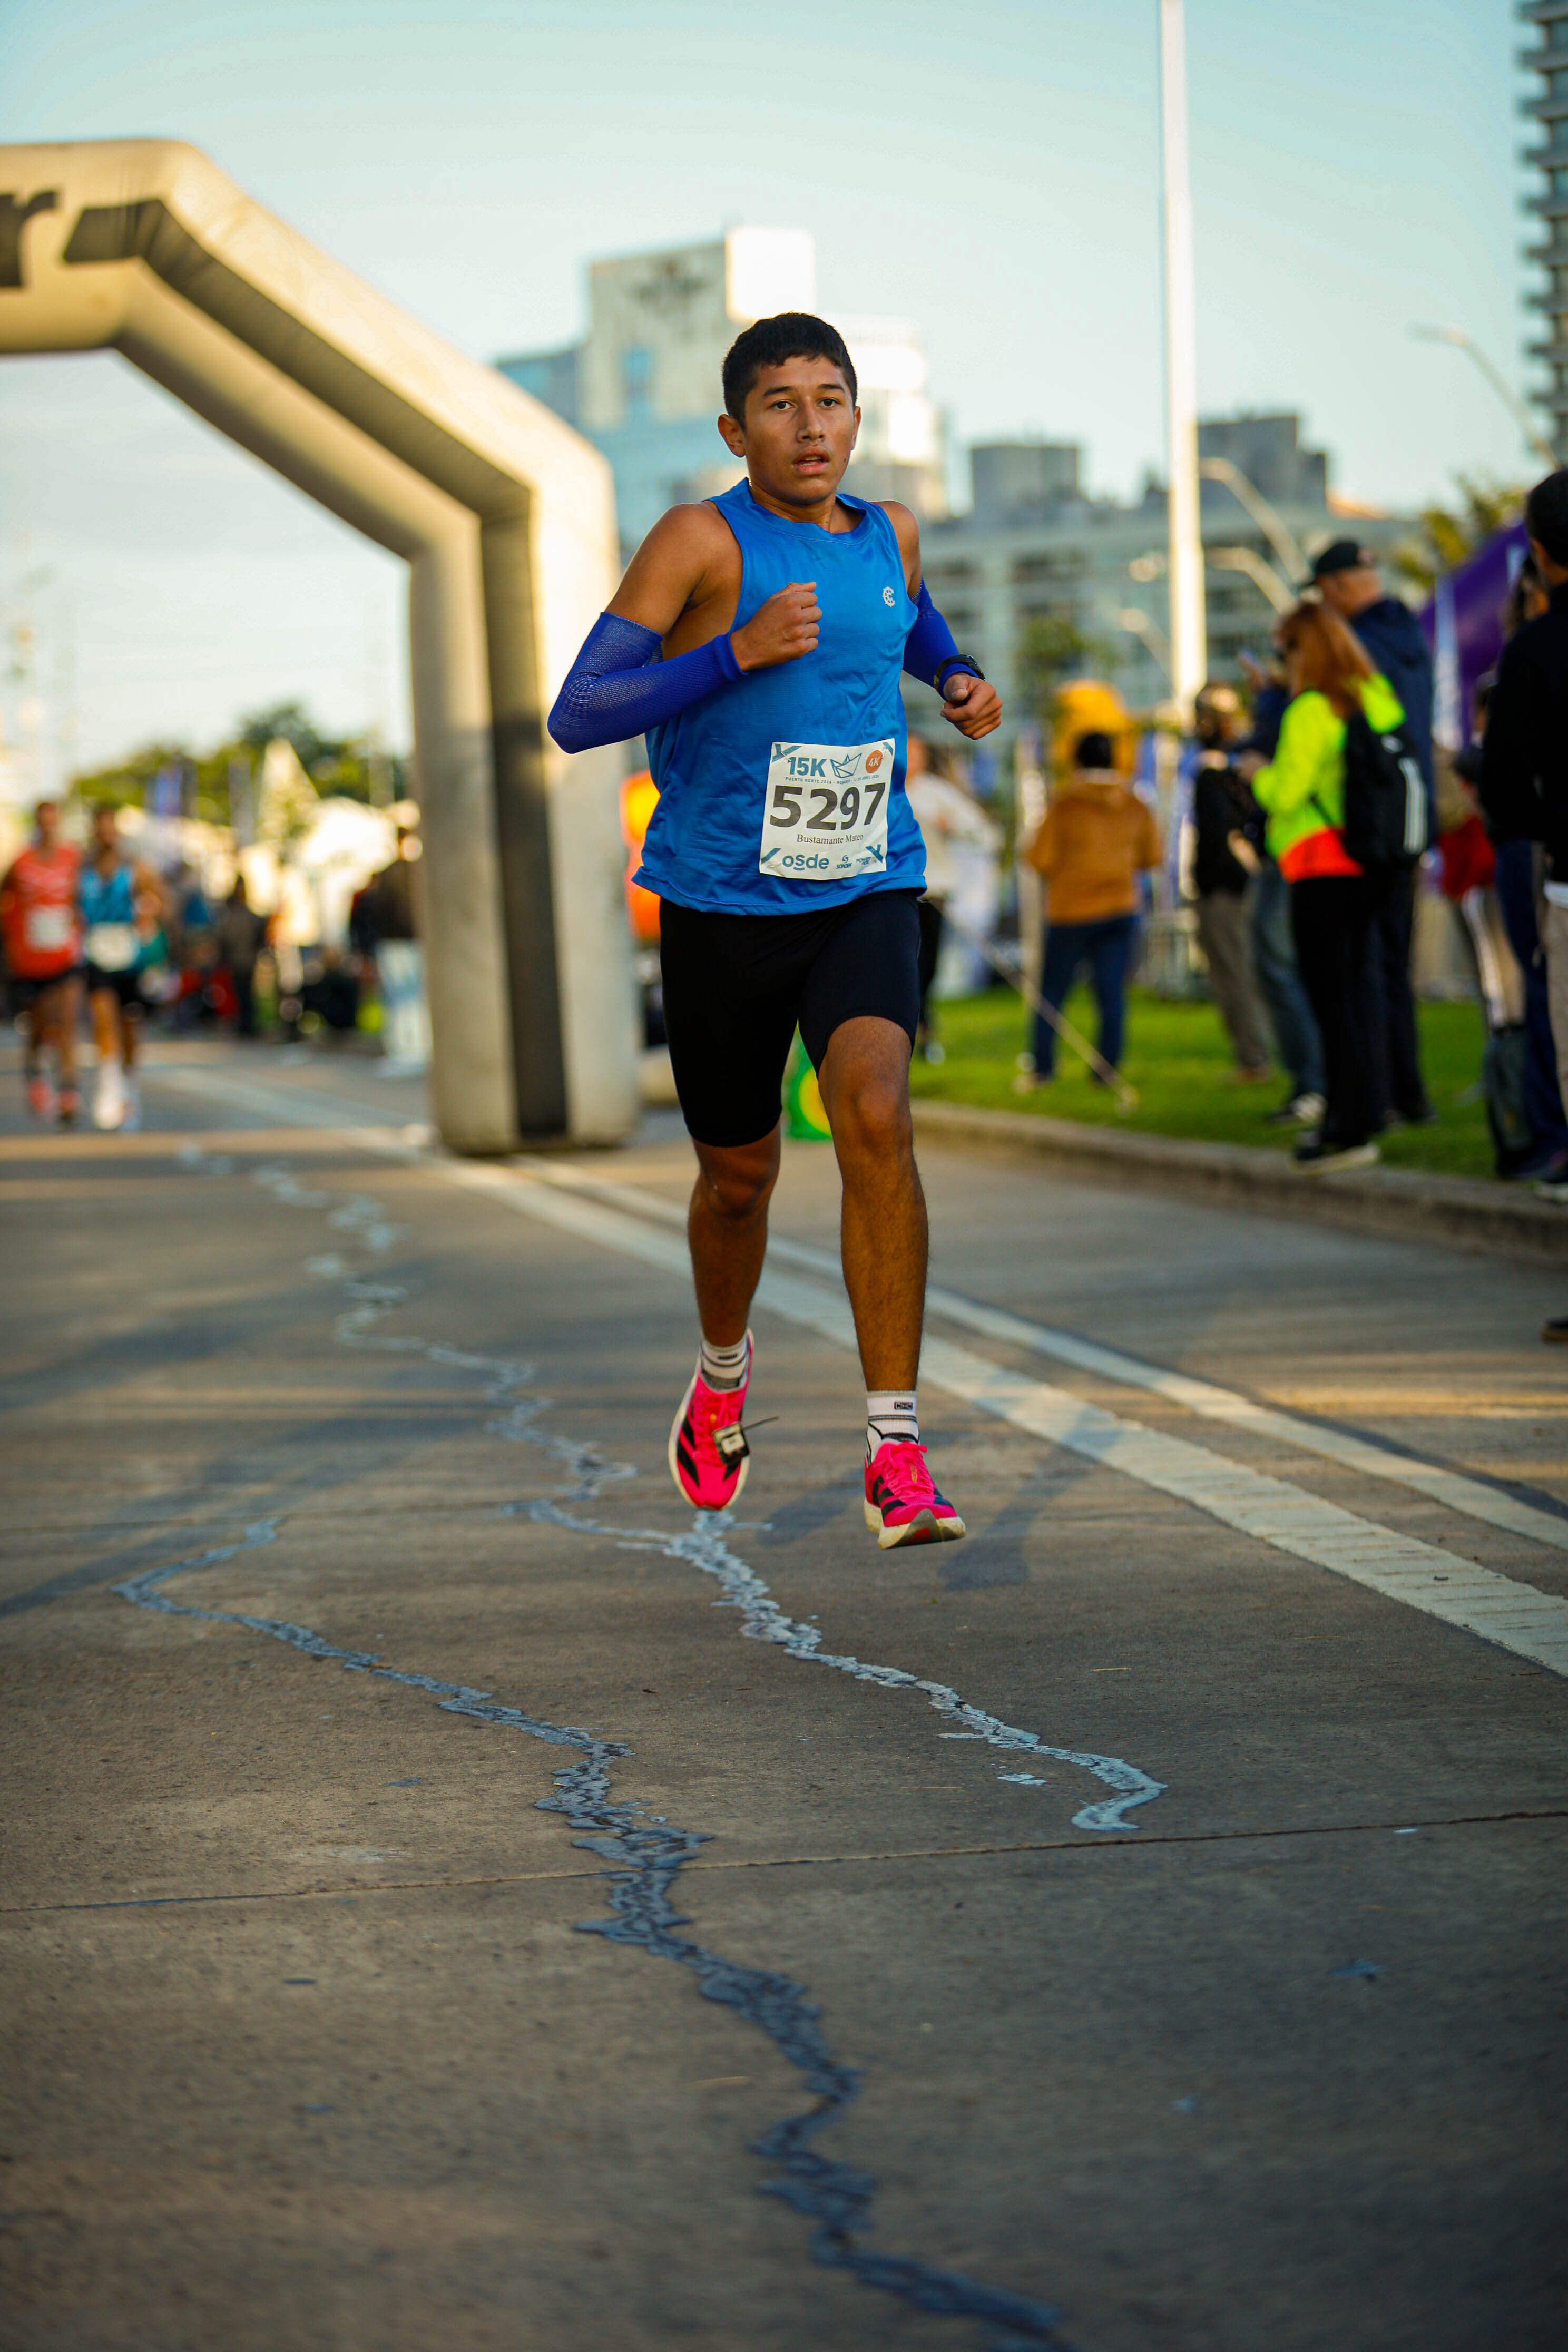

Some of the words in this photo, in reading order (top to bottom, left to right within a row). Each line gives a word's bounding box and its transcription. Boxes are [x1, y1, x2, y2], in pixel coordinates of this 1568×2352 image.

[788, 756, 827, 777] 15K
[868, 757, 880, 767] 4K
[770, 782, 886, 830] 5297
[797, 834, 844, 844] Bustamante
[845, 834, 863, 842] Mateo
[782, 853, 829, 870] osde
